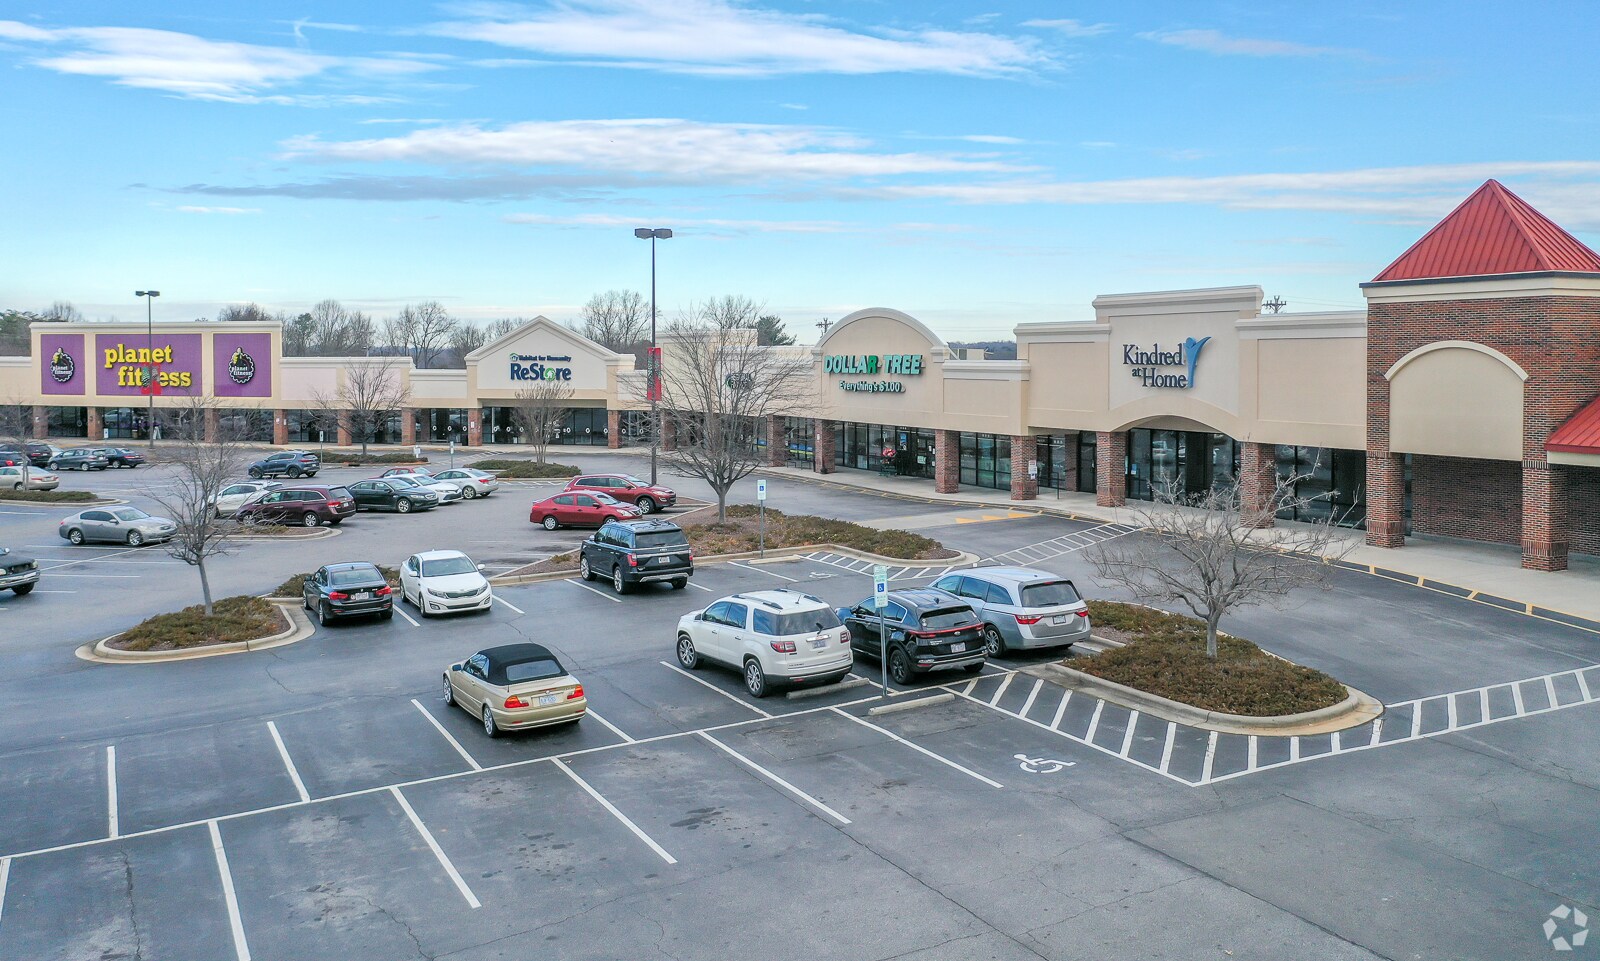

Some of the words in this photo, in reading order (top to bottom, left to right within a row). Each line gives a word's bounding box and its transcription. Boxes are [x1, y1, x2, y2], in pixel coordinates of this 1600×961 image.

[104, 343, 173, 369] planet
[823, 355, 878, 375] DOLLAR
[883, 354, 923, 375] TREE
[1122, 342, 1184, 366] Kindred
[118, 366, 192, 388] fitess
[510, 362, 572, 381] ReStore
[1131, 367, 1142, 377] at
[1142, 367, 1188, 388] Home
[839, 380, 877, 393] Everything's
[878, 380, 902, 393] $1.00
